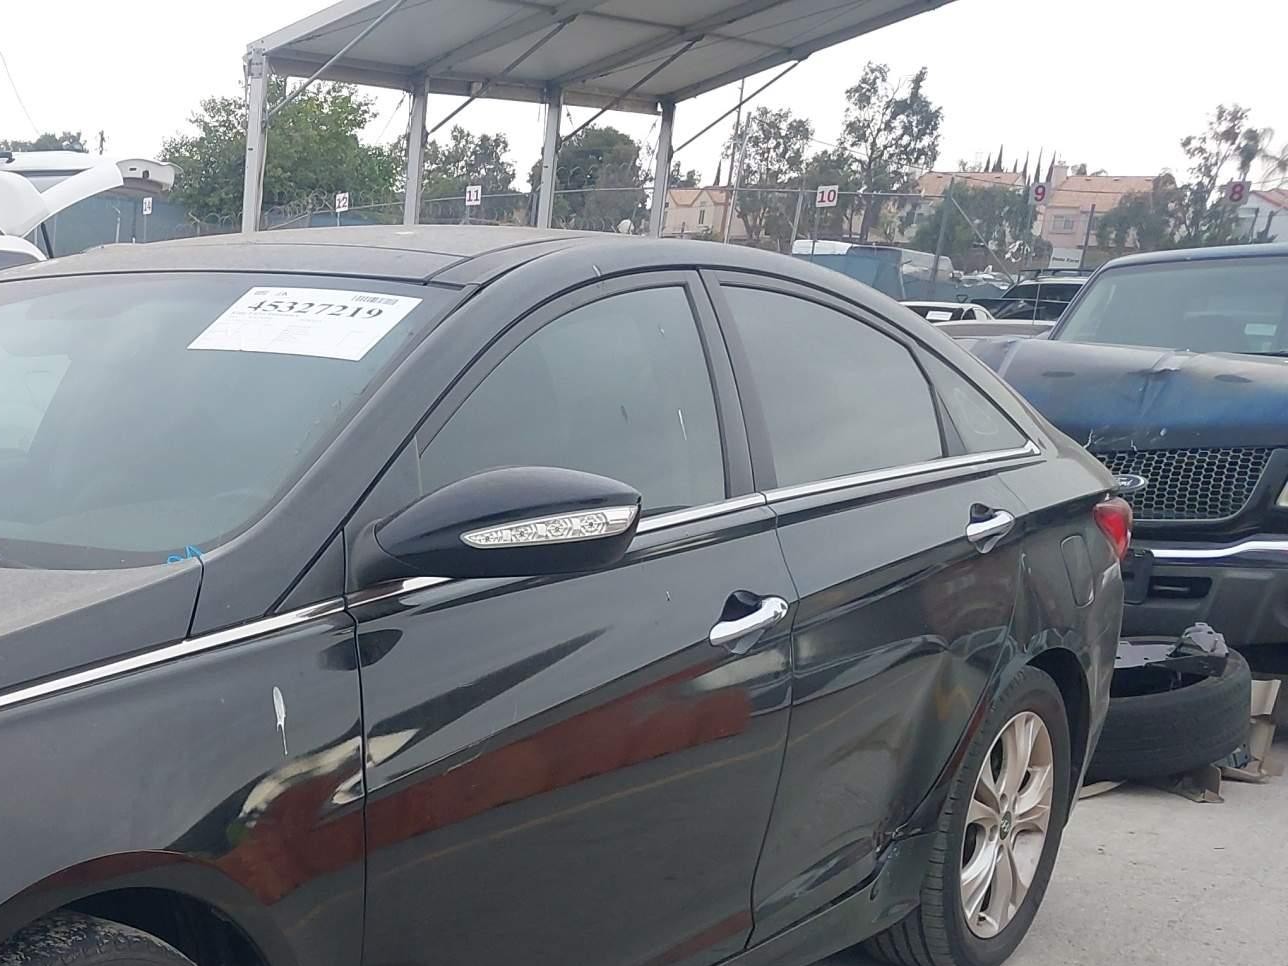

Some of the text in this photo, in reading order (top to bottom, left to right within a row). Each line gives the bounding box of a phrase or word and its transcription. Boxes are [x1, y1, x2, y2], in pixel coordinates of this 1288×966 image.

[466, 189, 480, 202] 11
[817, 189, 837, 203] 10
[1034, 184, 1046, 202] 9
[1229, 183, 1245, 202] 8
[143, 199, 152, 212] 14
[336, 195, 349, 209] 12
[248, 299, 384, 319] 45327219
